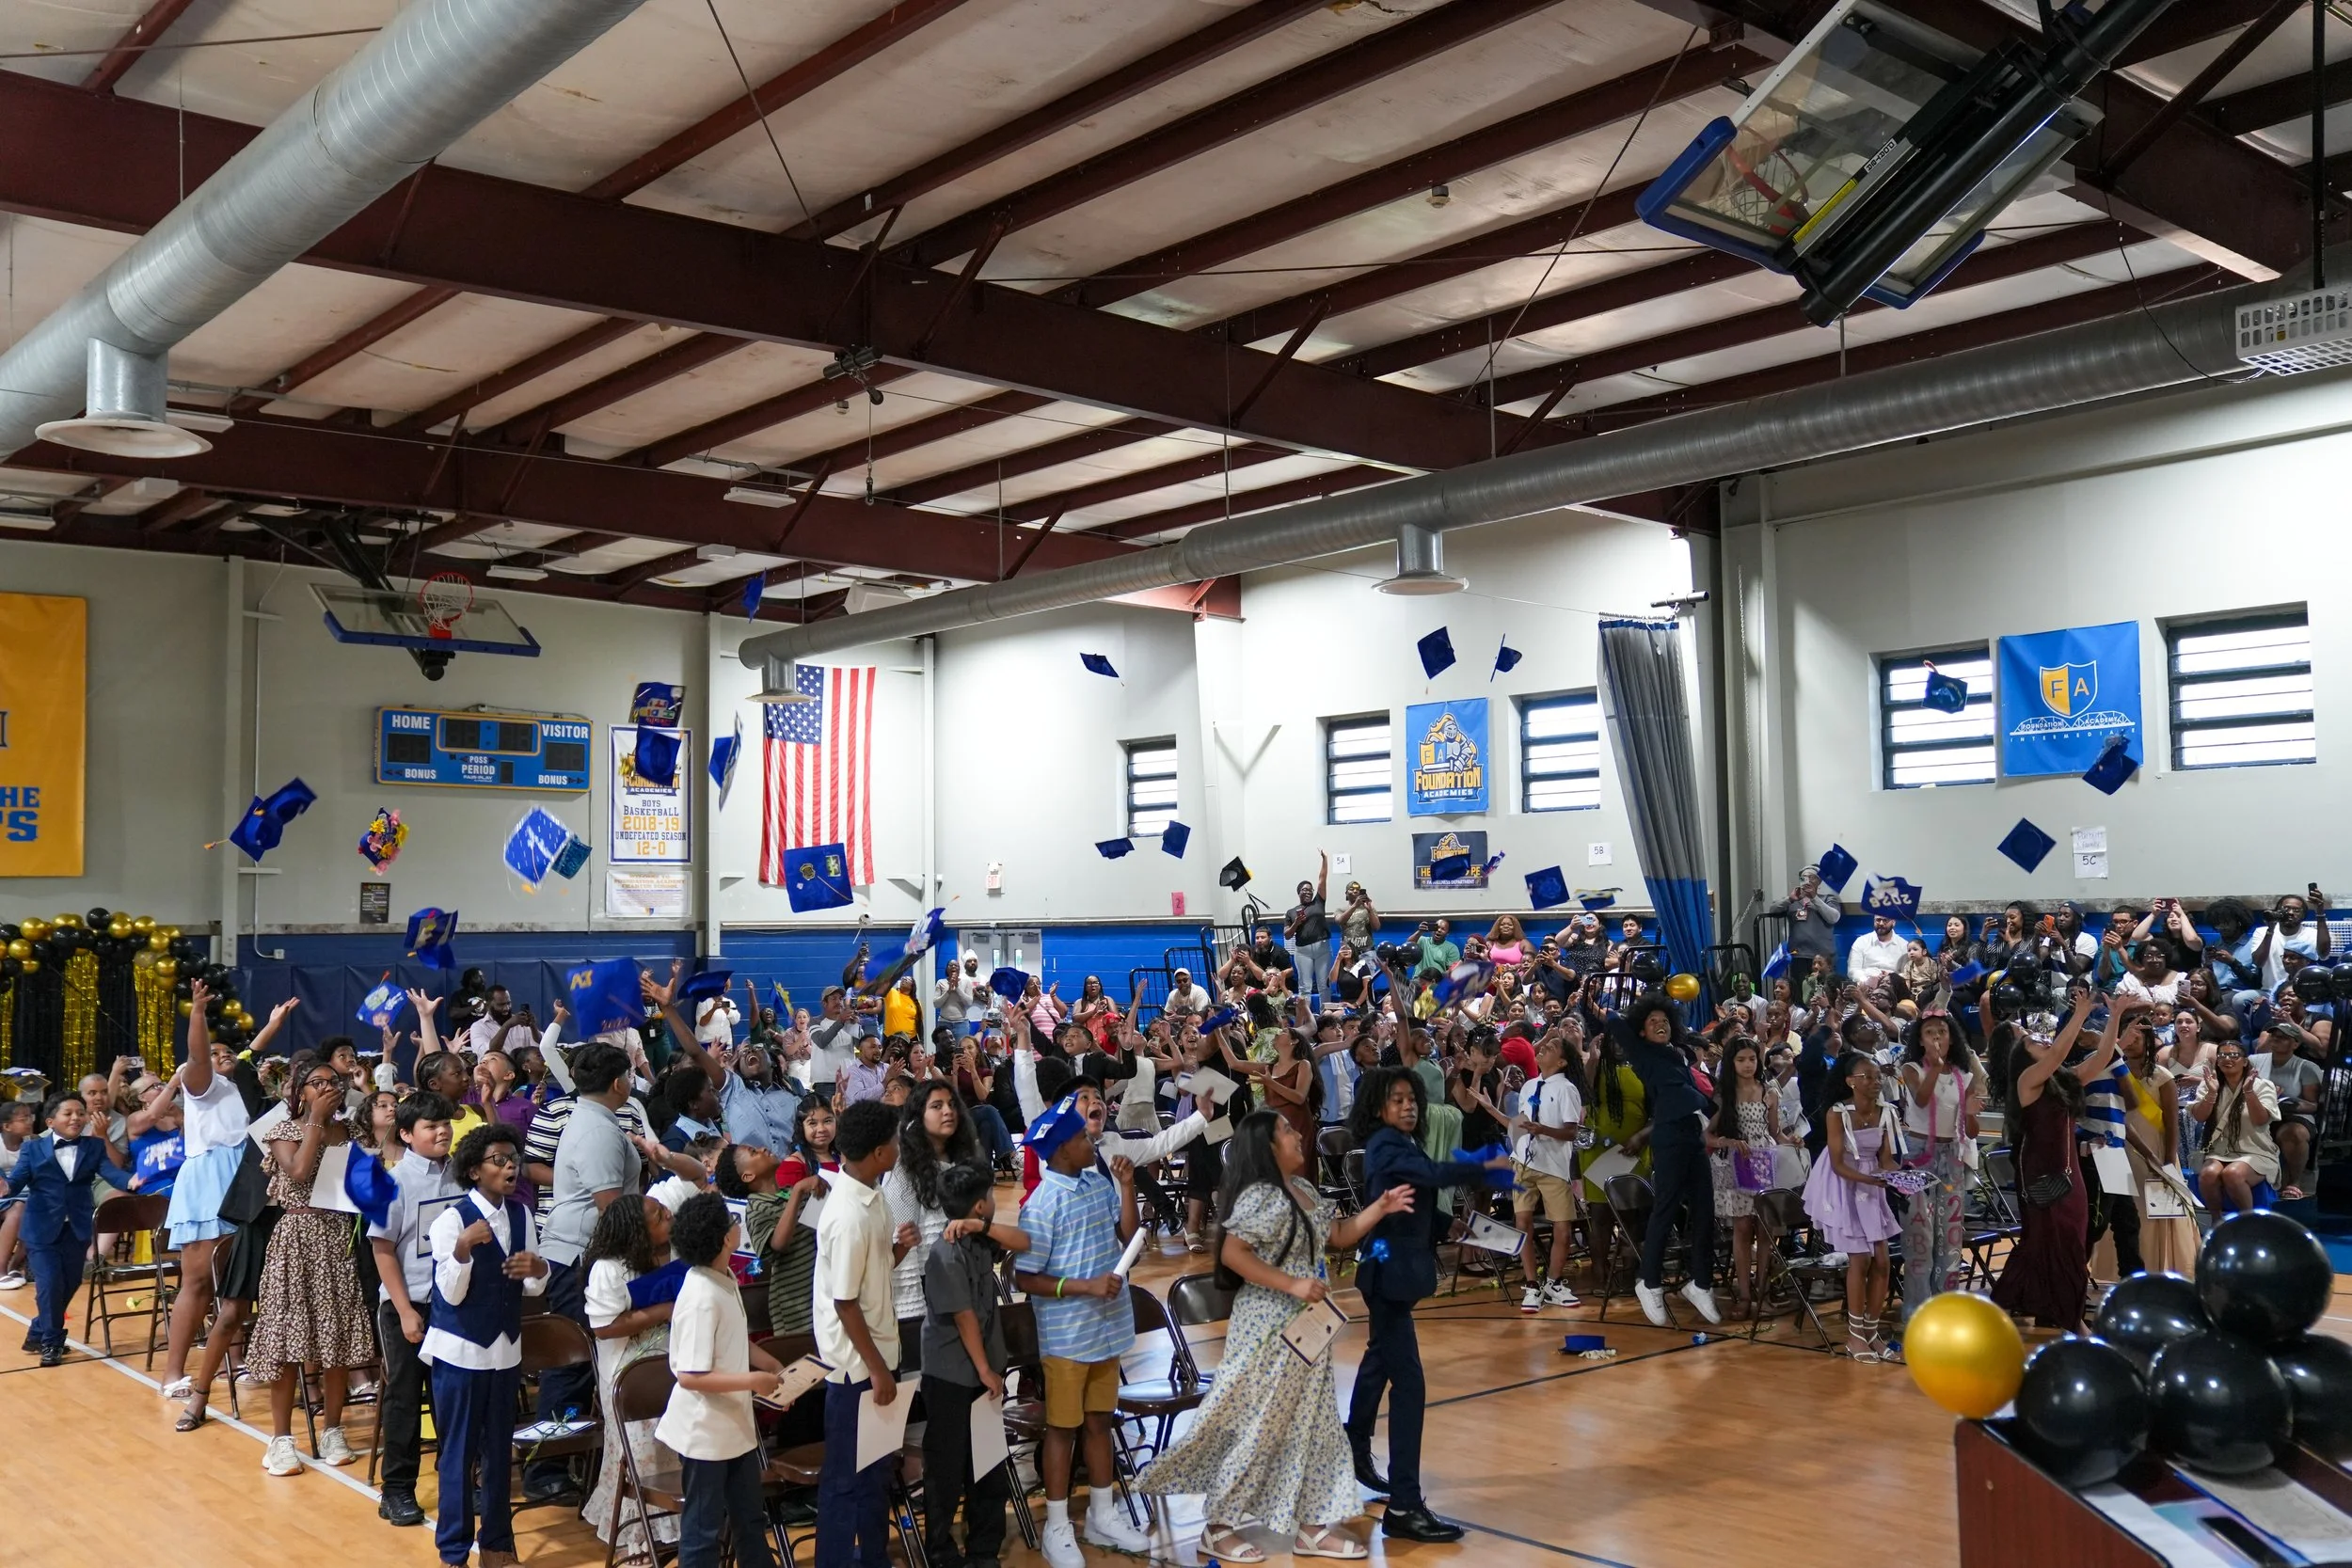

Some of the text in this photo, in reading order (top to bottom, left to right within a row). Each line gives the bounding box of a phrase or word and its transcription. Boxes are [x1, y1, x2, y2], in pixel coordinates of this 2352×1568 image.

[391, 715, 431, 730] HOME
[2022, 716, 2119, 731] FOUNDATION ACADEMY
[541, 723, 589, 739] VISITOR
[469, 755, 488, 765] POSS
[405, 768, 437, 780] BONUS
[461, 764, 496, 776] PERIOD
[538, 774, 568, 785] BONUS
[1415, 766, 1481, 791] FOUNDATION
[1423, 788, 1473, 799] ACADEMIES
[642, 800, 661, 808] BOYS
[623, 805, 679, 816] BASKETBALL
[622, 816, 680, 832] 2018-19
[615, 831, 687, 841] UNDEFEATED SEASON
[636, 841, 666, 856] 12-0
[1336, 856, 1345, 865] 5A
[2082, 855, 2096, 865] 5C
[1470, 866, 1481, 877] PE
[1176, 898, 1182, 909] 2
